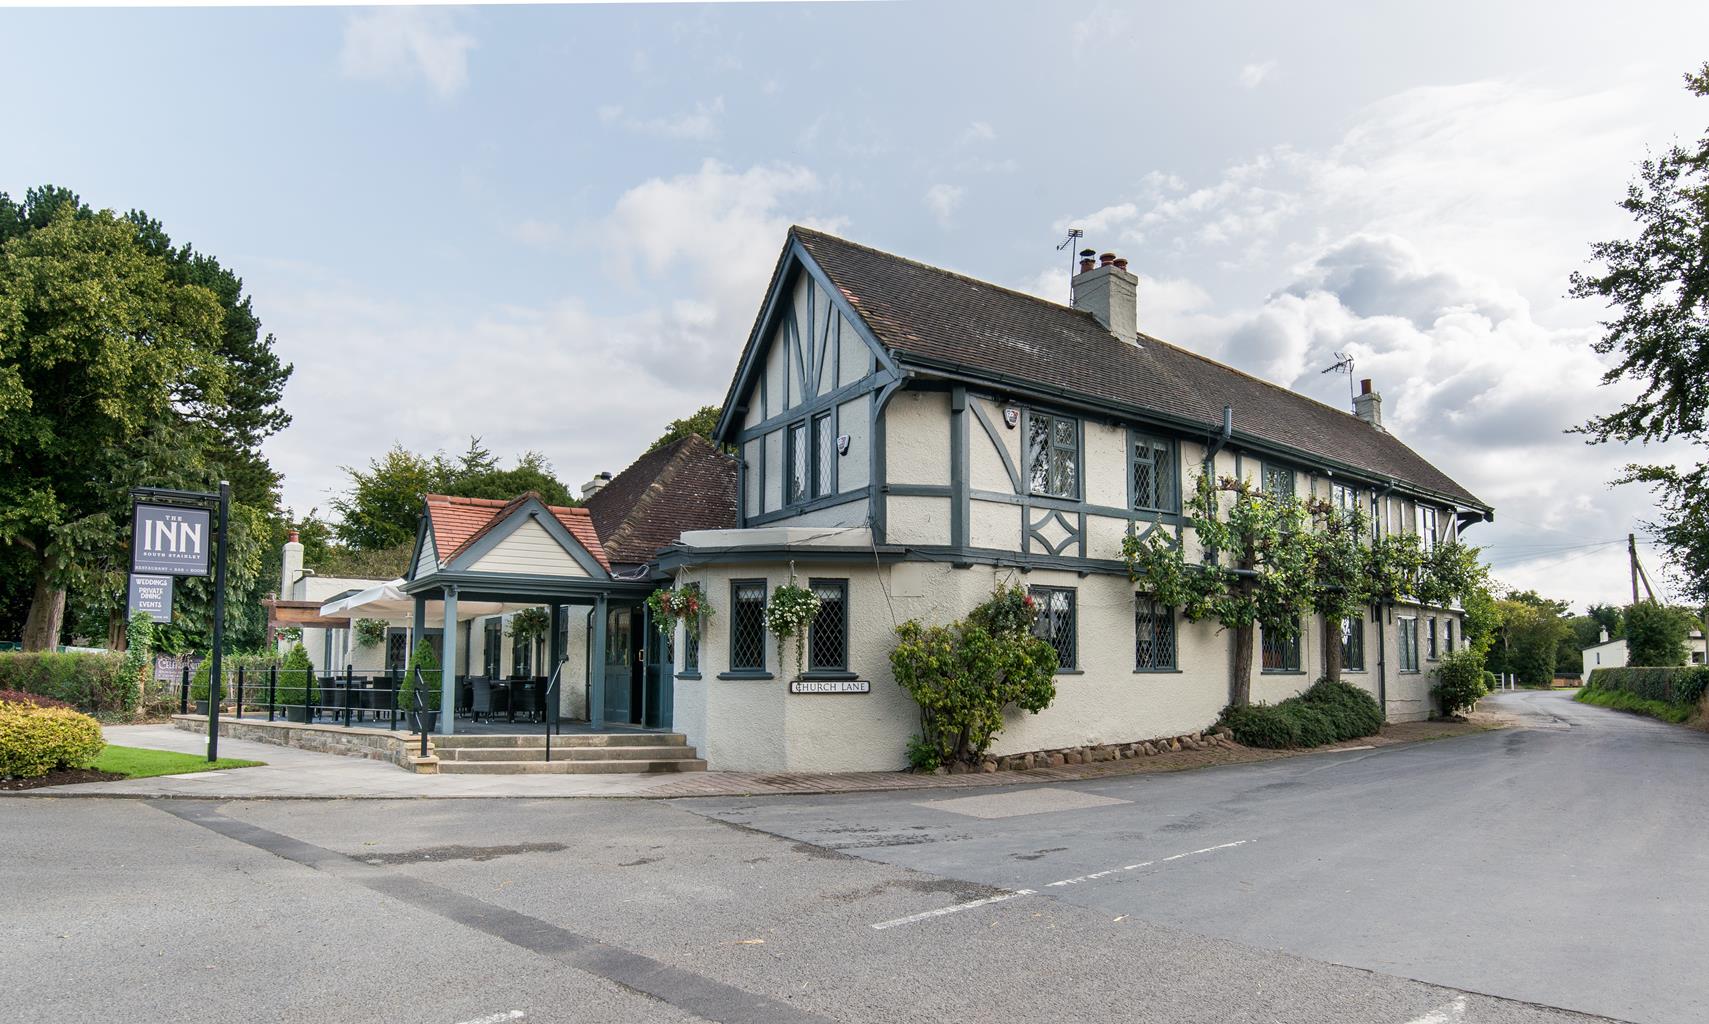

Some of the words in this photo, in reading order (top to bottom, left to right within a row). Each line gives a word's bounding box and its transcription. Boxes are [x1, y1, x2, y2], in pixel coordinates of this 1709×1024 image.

[144, 520, 201, 554] INN
[796, 682, 836, 692] CHURCH
[842, 682, 865, 690] LANE
